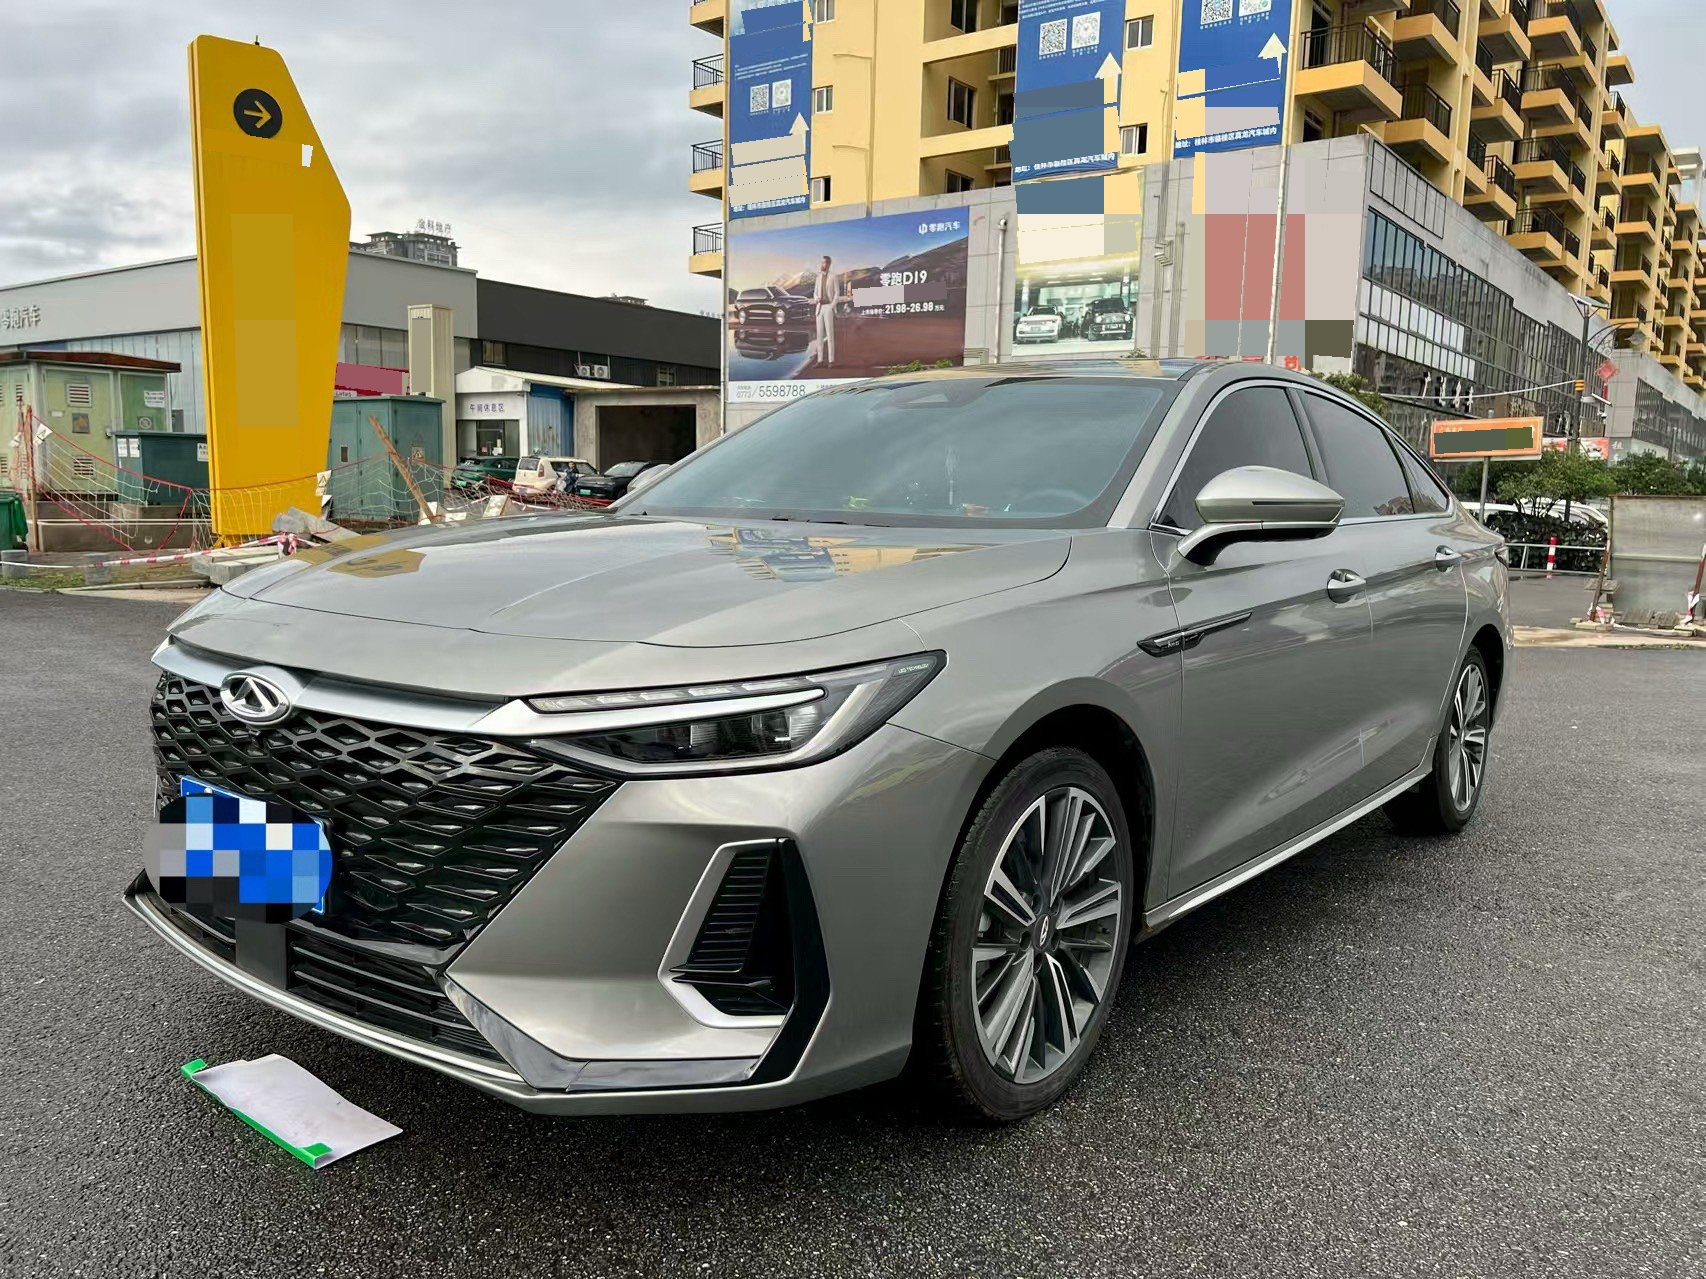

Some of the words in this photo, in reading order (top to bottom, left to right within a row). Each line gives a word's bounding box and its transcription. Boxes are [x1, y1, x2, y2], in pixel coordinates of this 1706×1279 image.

[929, 221, 961, 233] 零跑汽车
[880, 270, 928, 286] 零跑D19
